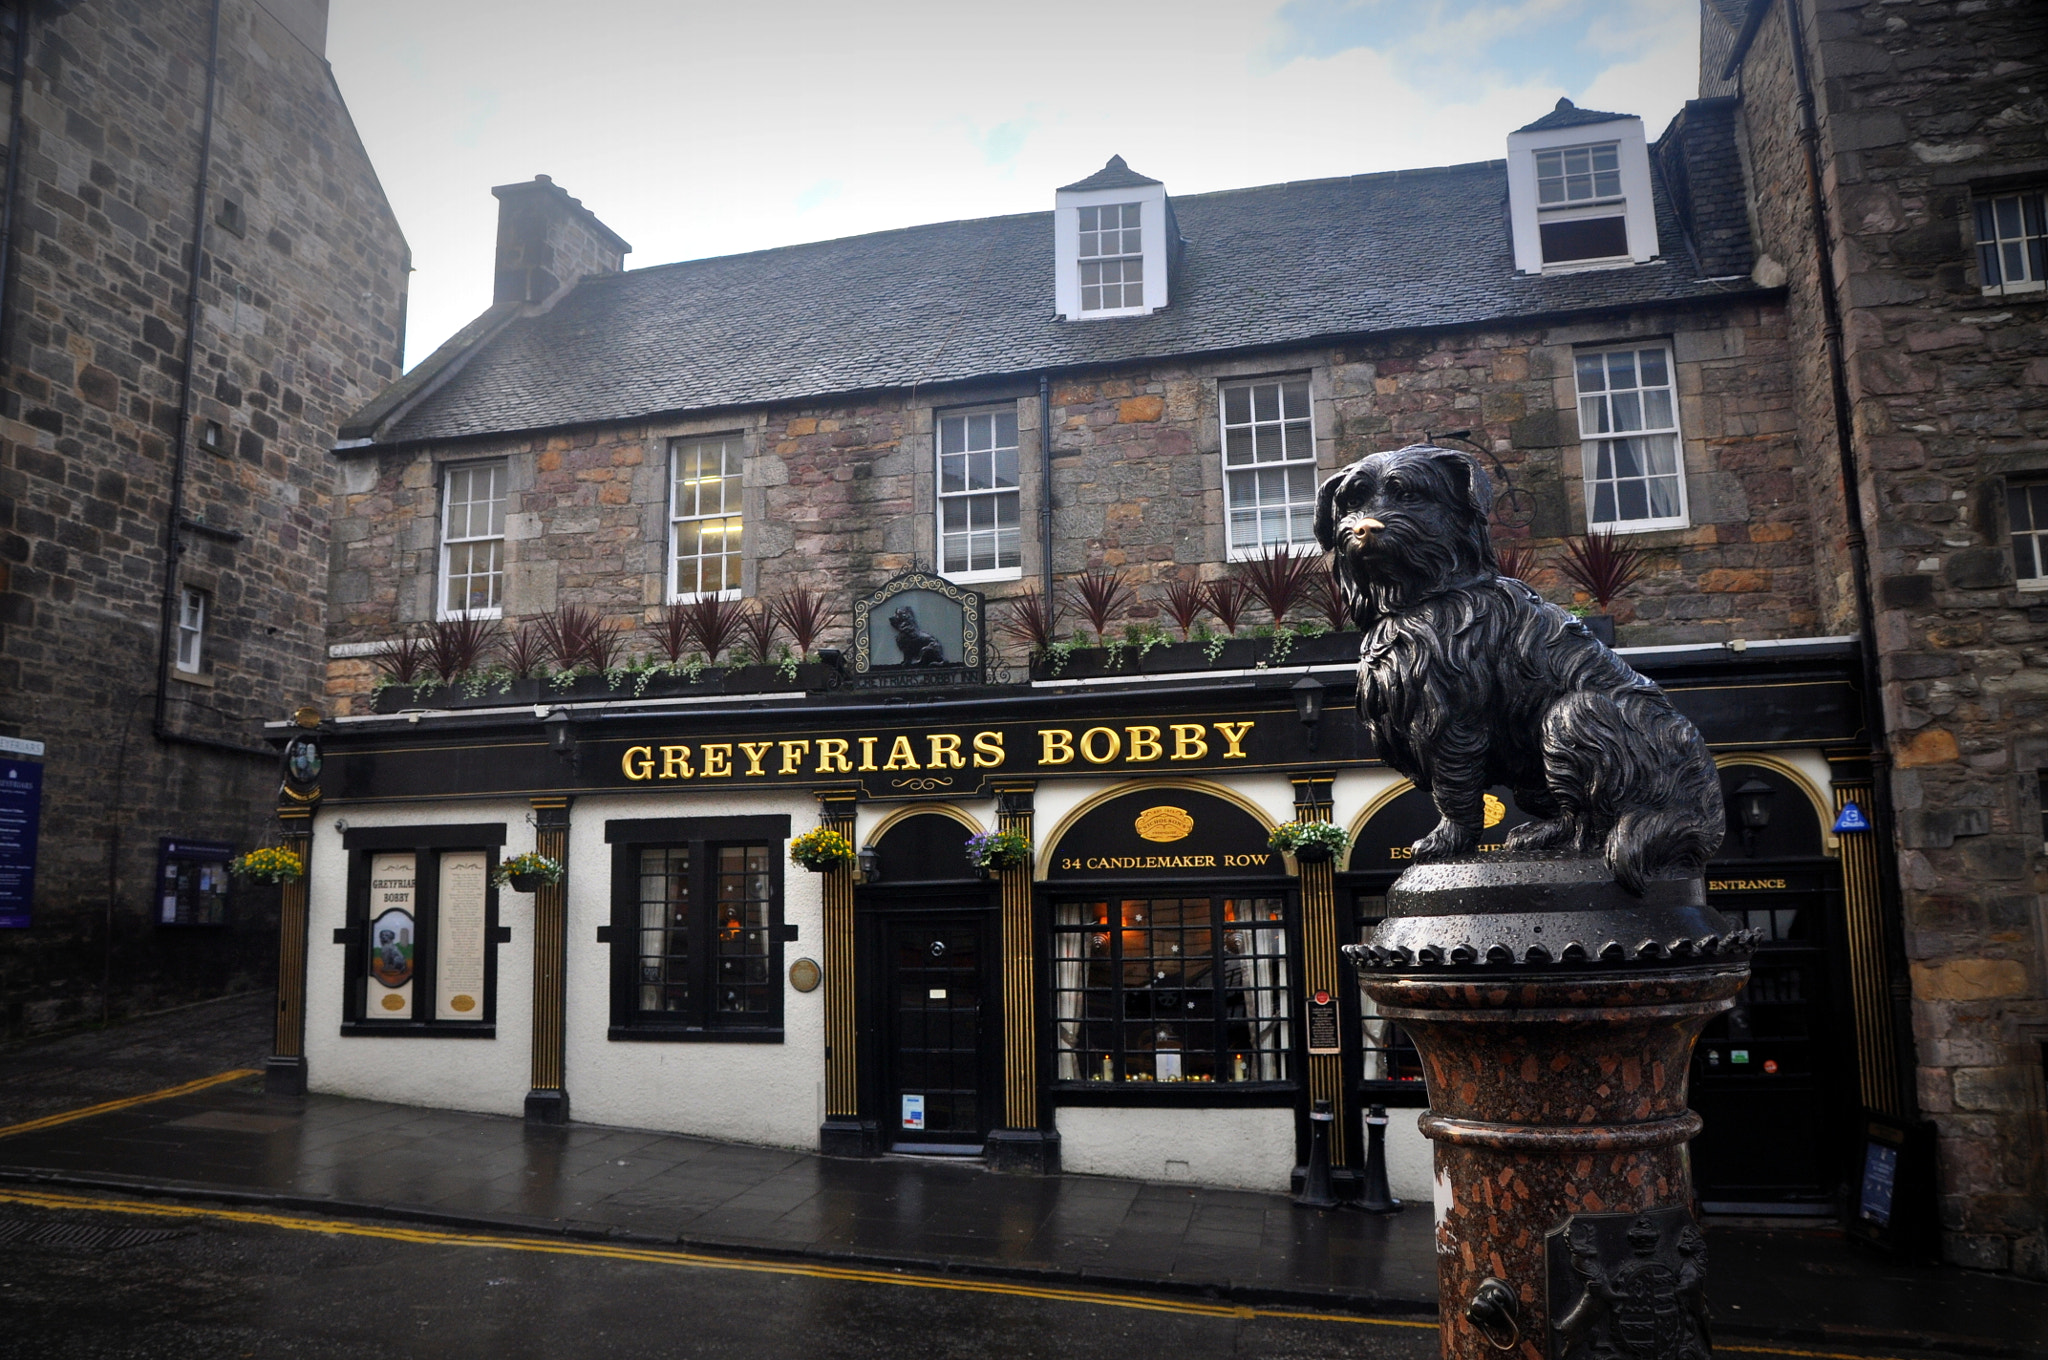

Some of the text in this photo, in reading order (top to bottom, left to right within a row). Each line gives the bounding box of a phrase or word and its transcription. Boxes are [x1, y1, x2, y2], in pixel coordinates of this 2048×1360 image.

[622, 721, 1255, 781] GREYFRIARS BOBBY
[1062, 854, 1270, 870] 34 CANDLEMAKER ROW
[1708, 879, 1786, 890] ENTRANCE
[383, 893, 409, 902] BOBBY
